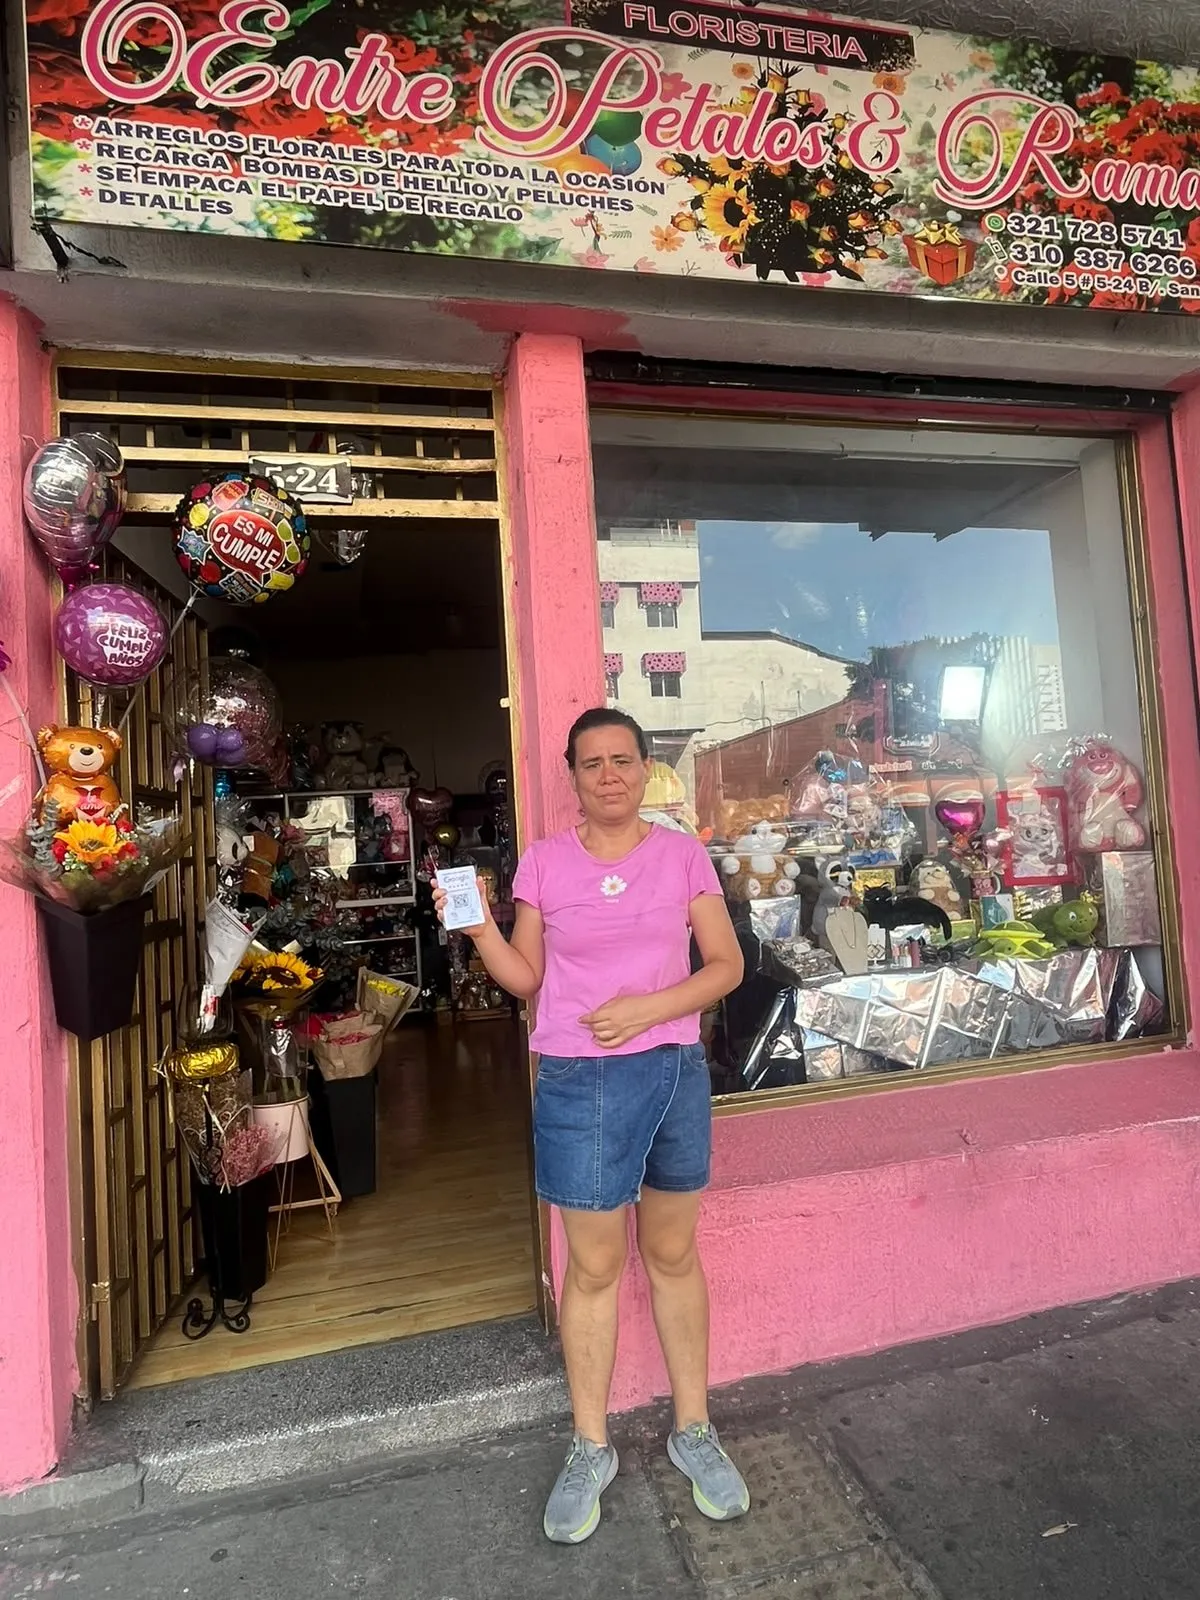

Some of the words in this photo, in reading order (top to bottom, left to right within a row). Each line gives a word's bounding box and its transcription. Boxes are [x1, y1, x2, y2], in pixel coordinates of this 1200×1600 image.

[624, 3, 868, 63] FLORISTERIA
[80, 0, 456, 121] Entre
[474, 26, 832, 172] Petalos
[846, 92, 906, 175] &
[94, 119, 244, 149] ARREGLOS
[252, 137, 383, 167] FLORALES
[392, 153, 455, 173] PARA
[463, 162, 524, 180] TODA
[532, 168, 559, 184] LA
[566, 172, 665, 196] OCASIÓN
[96, 143, 229, 171] RECARGA
[244, 158, 355, 183] BOMBAS
[364, 171, 395, 187] DE
[404, 175, 488, 196] HELLIO
[494, 185, 509, 199] Y
[517, 188, 634, 212] PELUCHES
[96, 166, 135, 182] SE
[141, 170, 252, 195] EMPACA
[261, 182, 291, 199] EL
[300, 186, 383, 207] PAPEL
[388, 197, 420, 212] DE
[428, 201, 523, 222] REGALO
[98, 189, 233, 215] DETALLES
[1008, 215, 1060, 238] 321
[1067, 221, 1117, 243] 728
[1123, 227, 1184, 249] 5741
[1012, 244, 1062, 265] 310
[1076, 250, 1124, 271] 387
[1132, 254, 1195, 276] 6266
[1013, 270, 1059, 286] Calle
[1065, 274, 1077, 286] 5
[1096, 278, 1134, 291] 5-24
[265, 466, 340, 493] 5-24
[213, 523, 281, 570] CUMPLE
[233, 515, 256, 536] ES
[255, 530, 274, 547] MI
[99, 635, 152, 654] CUMPLE
[110, 624, 147, 640] FELIZ
[109, 651, 143, 665] AÑOS
